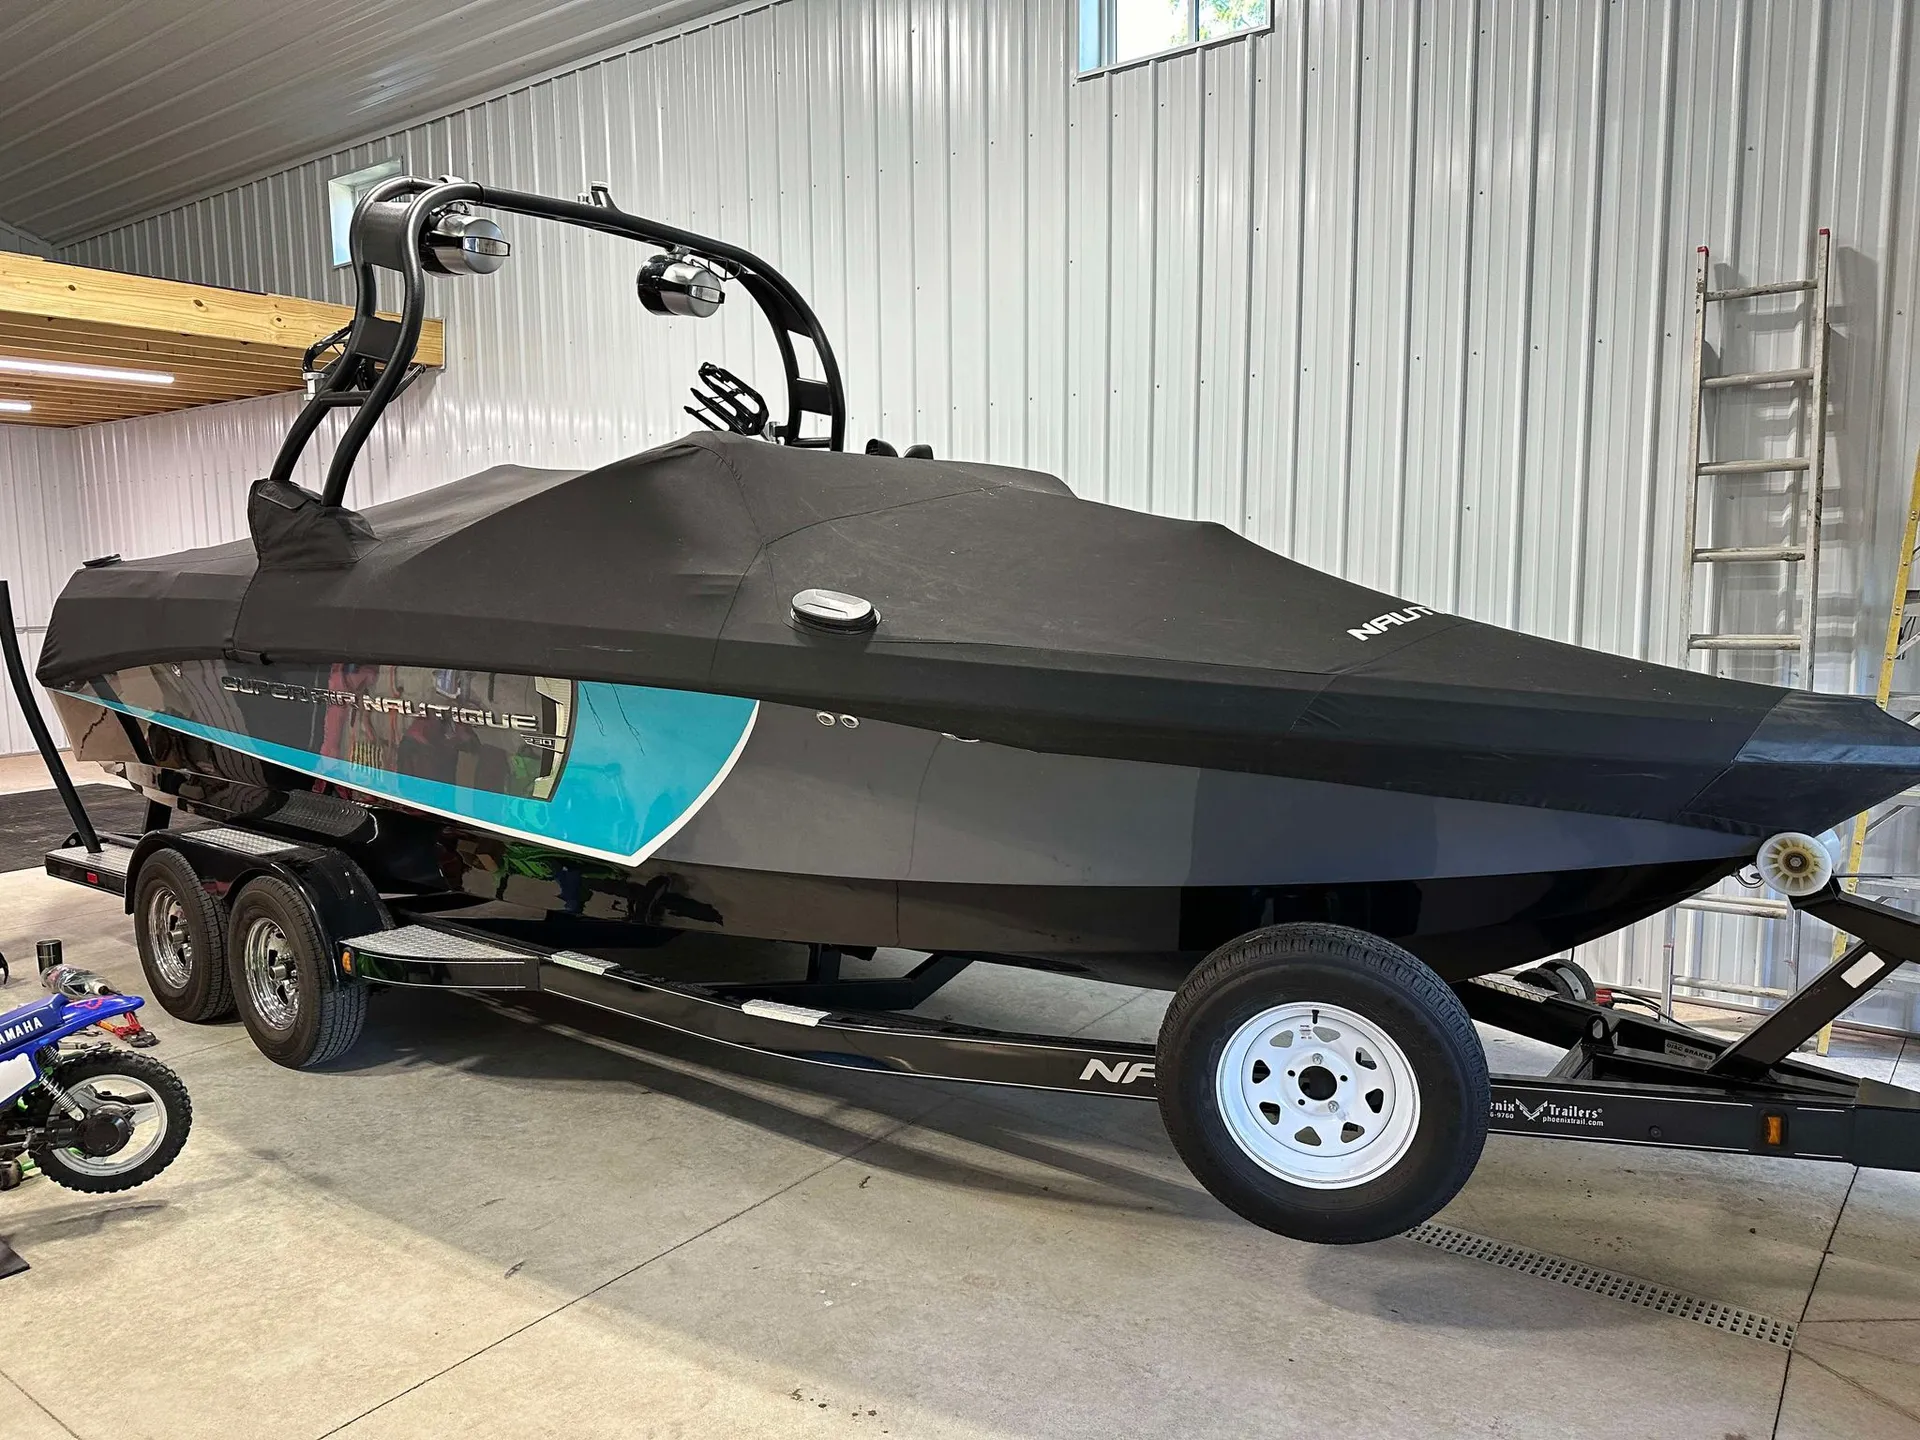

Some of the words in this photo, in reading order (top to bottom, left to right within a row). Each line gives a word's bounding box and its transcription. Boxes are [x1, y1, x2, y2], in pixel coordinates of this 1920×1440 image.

[221, 676, 309, 702] SUPER
[310, 688, 359, 709] AIR
[362, 694, 538, 732] NAUTIQUE
[1684, 1047, 1713, 1060] BRAKES
[1542, 1115, 1604, 1127] phoenixtrail.com
